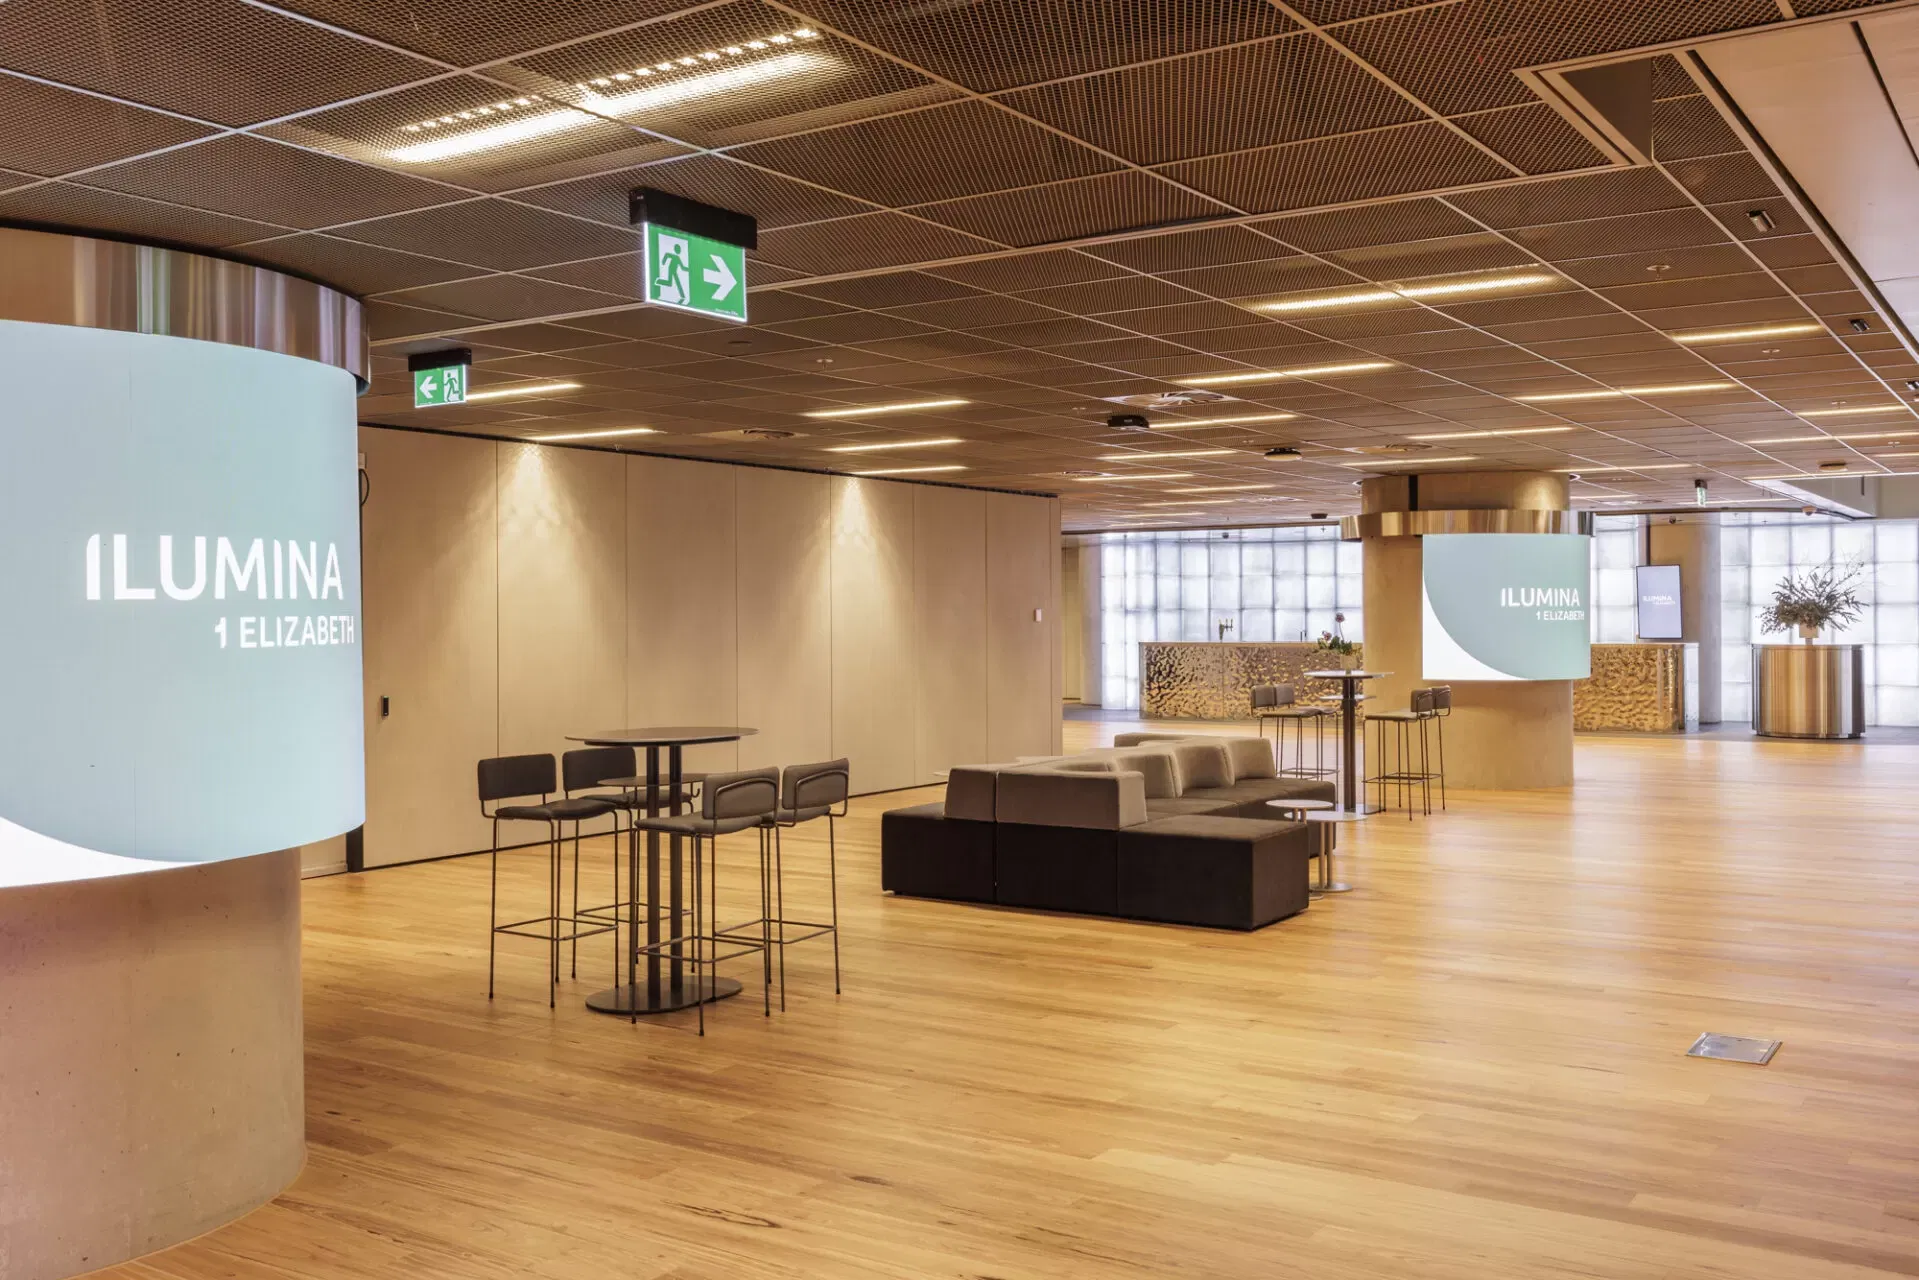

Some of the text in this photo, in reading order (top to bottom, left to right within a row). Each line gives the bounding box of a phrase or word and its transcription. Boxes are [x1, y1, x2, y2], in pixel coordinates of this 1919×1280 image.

[86, 533, 344, 601] ILUMINA
[1501, 587, 1580, 607] ILUMINA
[1536, 610, 1541, 621] 1
[214, 615, 355, 649] 1 ELIZABETH
